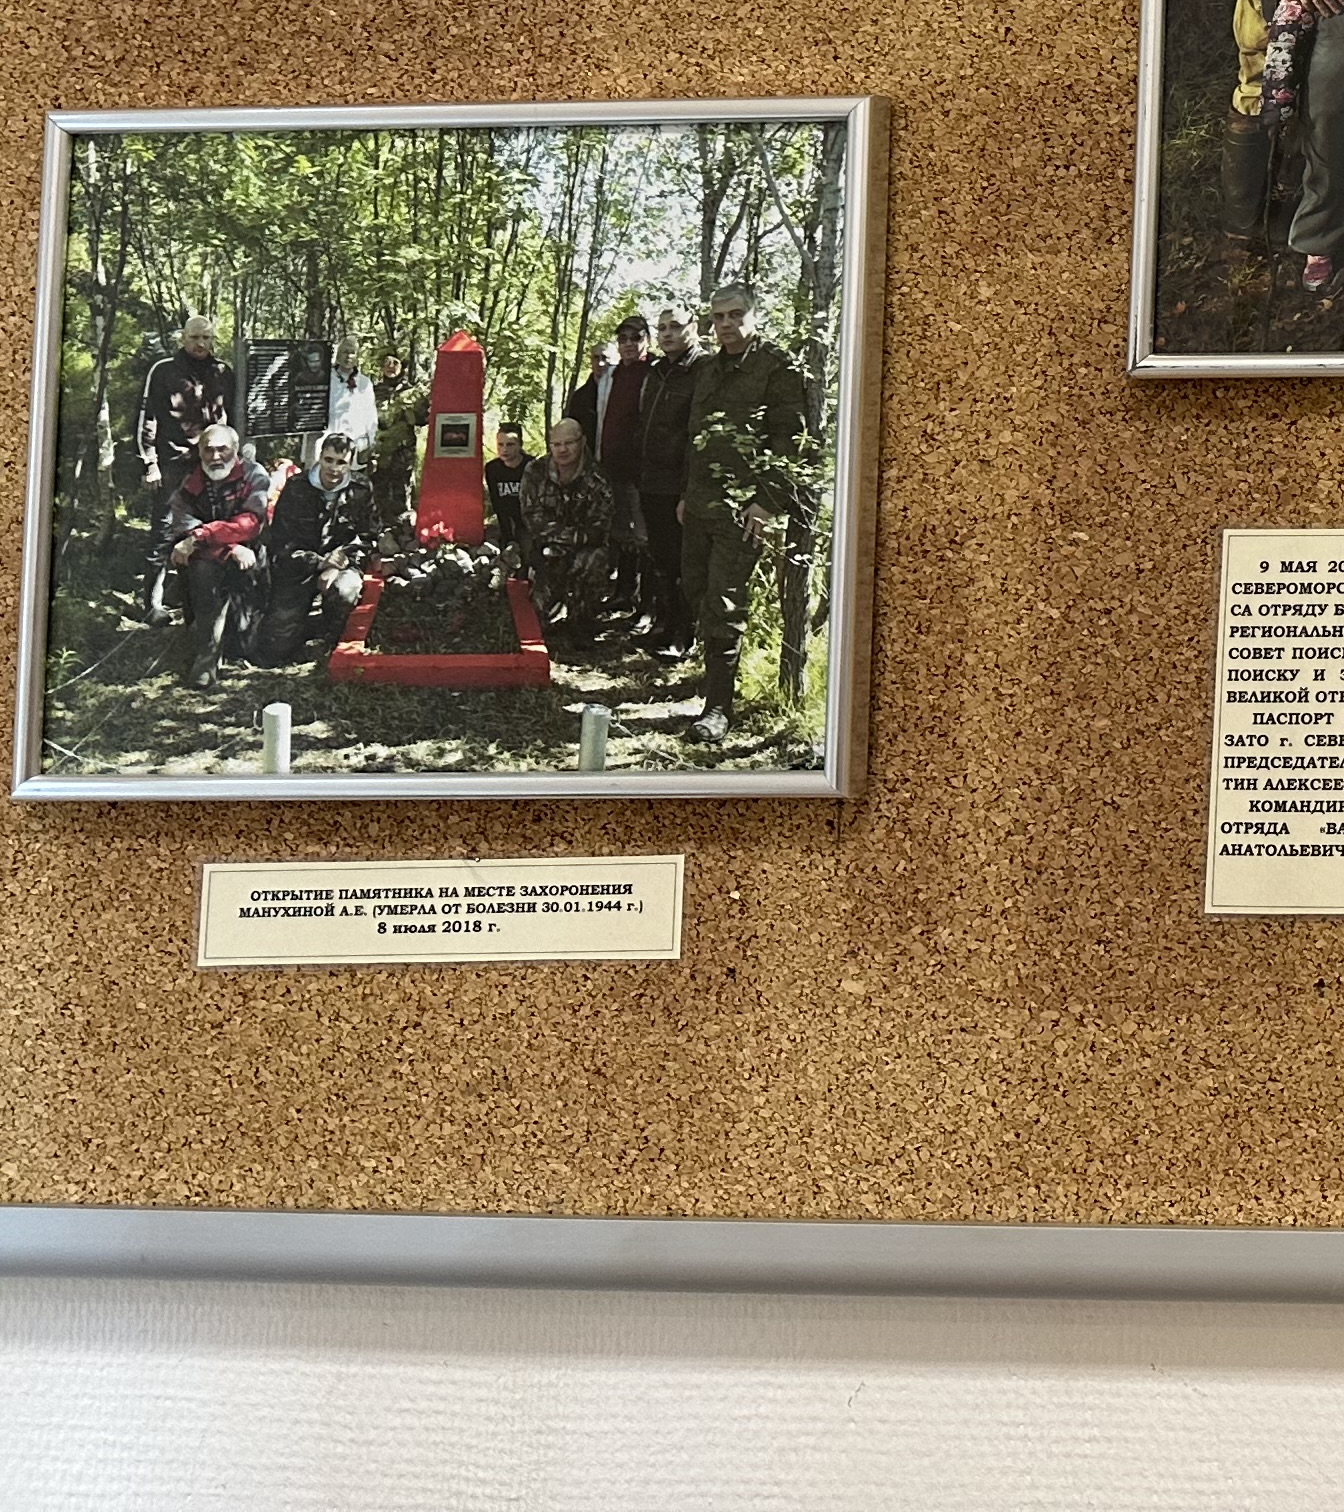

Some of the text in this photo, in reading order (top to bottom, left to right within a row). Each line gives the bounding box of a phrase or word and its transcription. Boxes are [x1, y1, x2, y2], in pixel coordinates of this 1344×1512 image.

[1258, 559, 1270, 574] 9
[1278, 559, 1319, 574] МАЯ
[1224, 685, 1311, 704] ВЕЛИКОЙ
[1251, 711, 1335, 726] ПАСПОРТ
[1221, 776, 1259, 791] ТИН
[1219, 820, 1291, 837] ОТРЯДА
[249, 882, 634, 902] ОТКРЫТИЕ ПАМЯТНИКА НА МЕСТЕ ЗАХОРОНЕНИЯ
[237, 898, 644, 919] МАНУХИНОЙ А.Е. (УМЕРЛА ОТ БОЛЕЗНИ 30.01.1944 г.)
[376, 918, 501, 935] 8 июля 2018 г.
